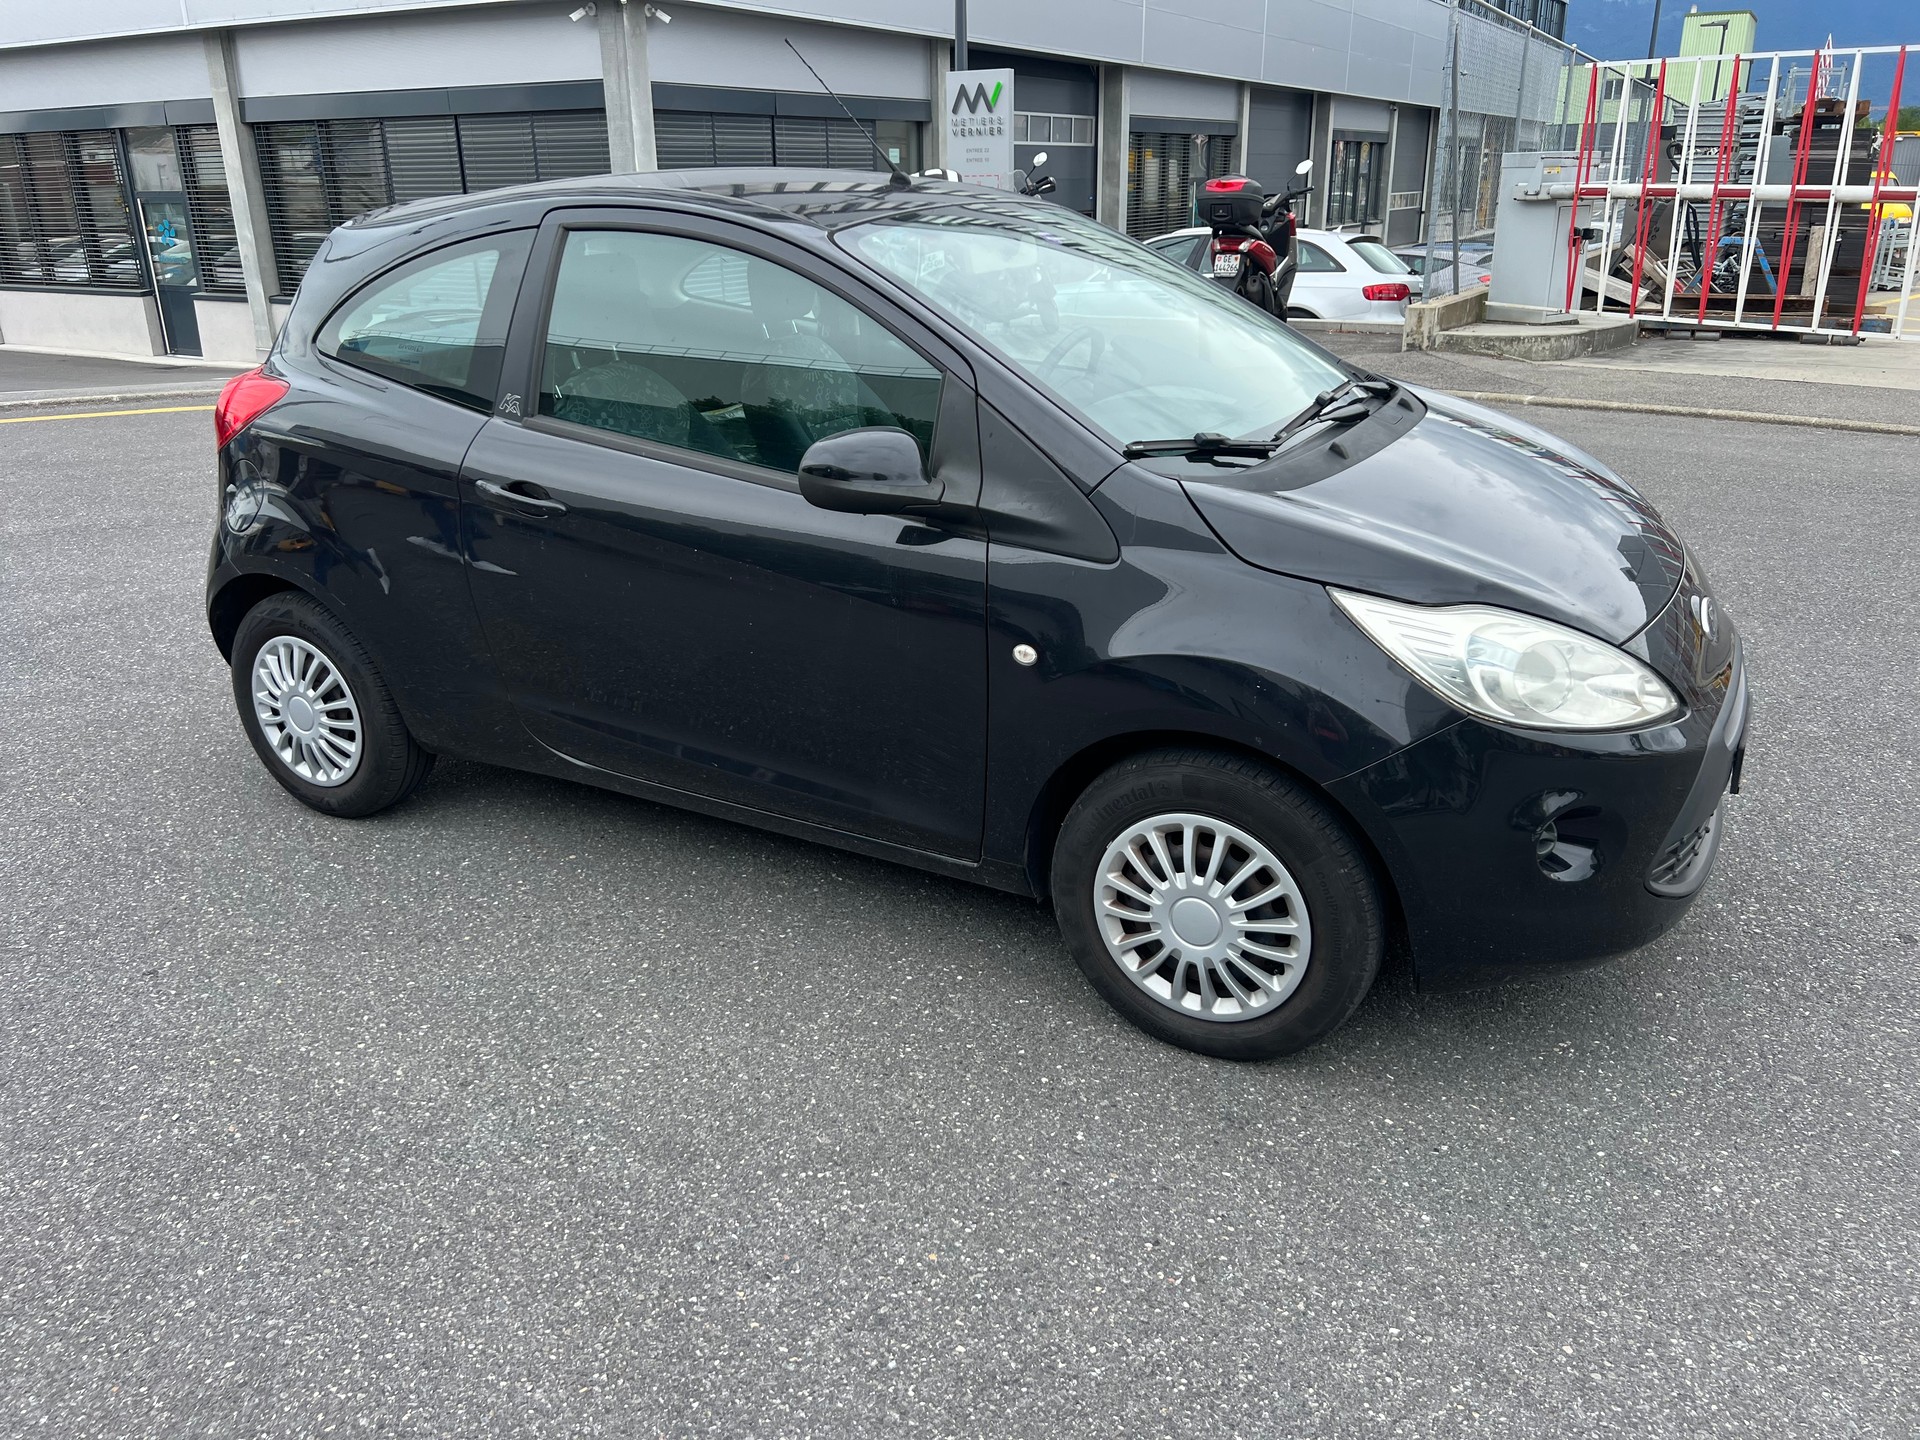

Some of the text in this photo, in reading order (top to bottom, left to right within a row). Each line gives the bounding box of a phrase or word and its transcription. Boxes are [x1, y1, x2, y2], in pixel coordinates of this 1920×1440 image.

[952, 127, 1004, 137] VERNIER
[1223, 255, 1232, 263] GE
[1215, 264, 1238, 272] 144266
